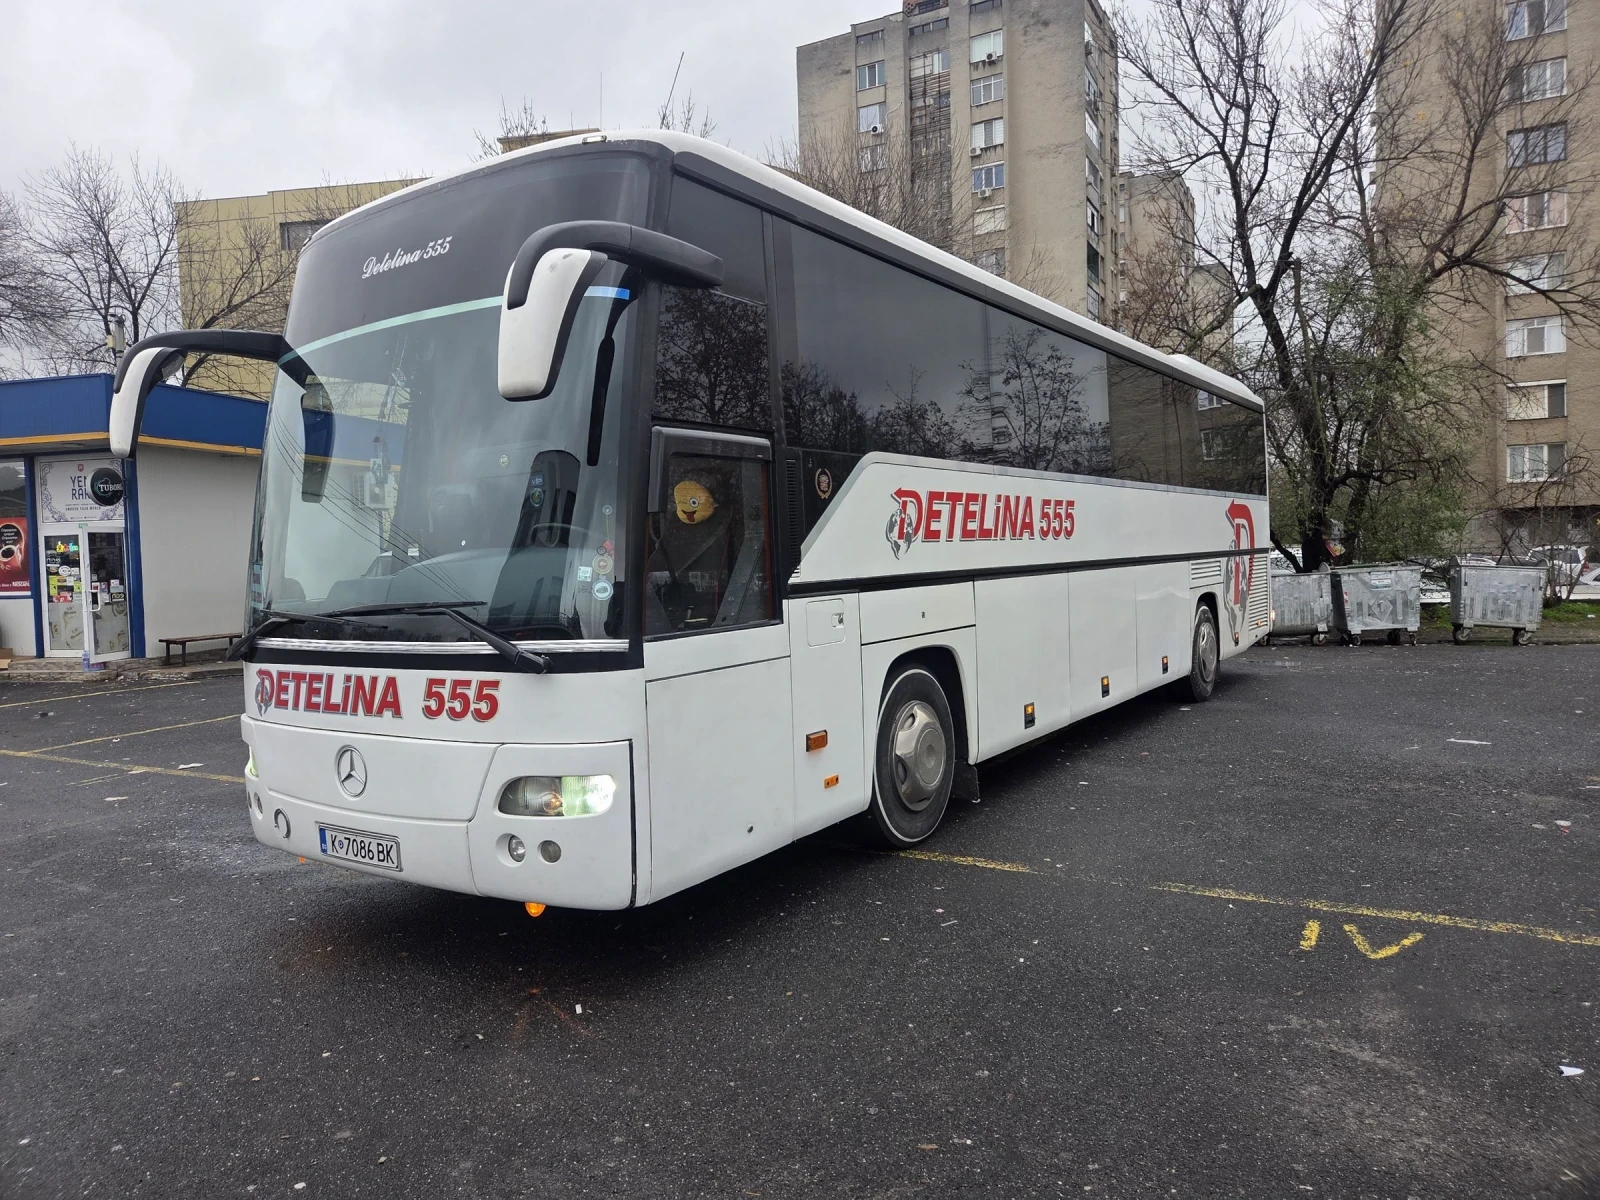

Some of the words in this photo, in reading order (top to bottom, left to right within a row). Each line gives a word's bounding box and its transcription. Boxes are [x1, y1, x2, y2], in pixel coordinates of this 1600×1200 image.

[423, 236, 453, 259] 555
[1039, 498, 1076, 541] 555
[422, 677, 502, 722] 555
[344, 836, 375, 861] 7086
